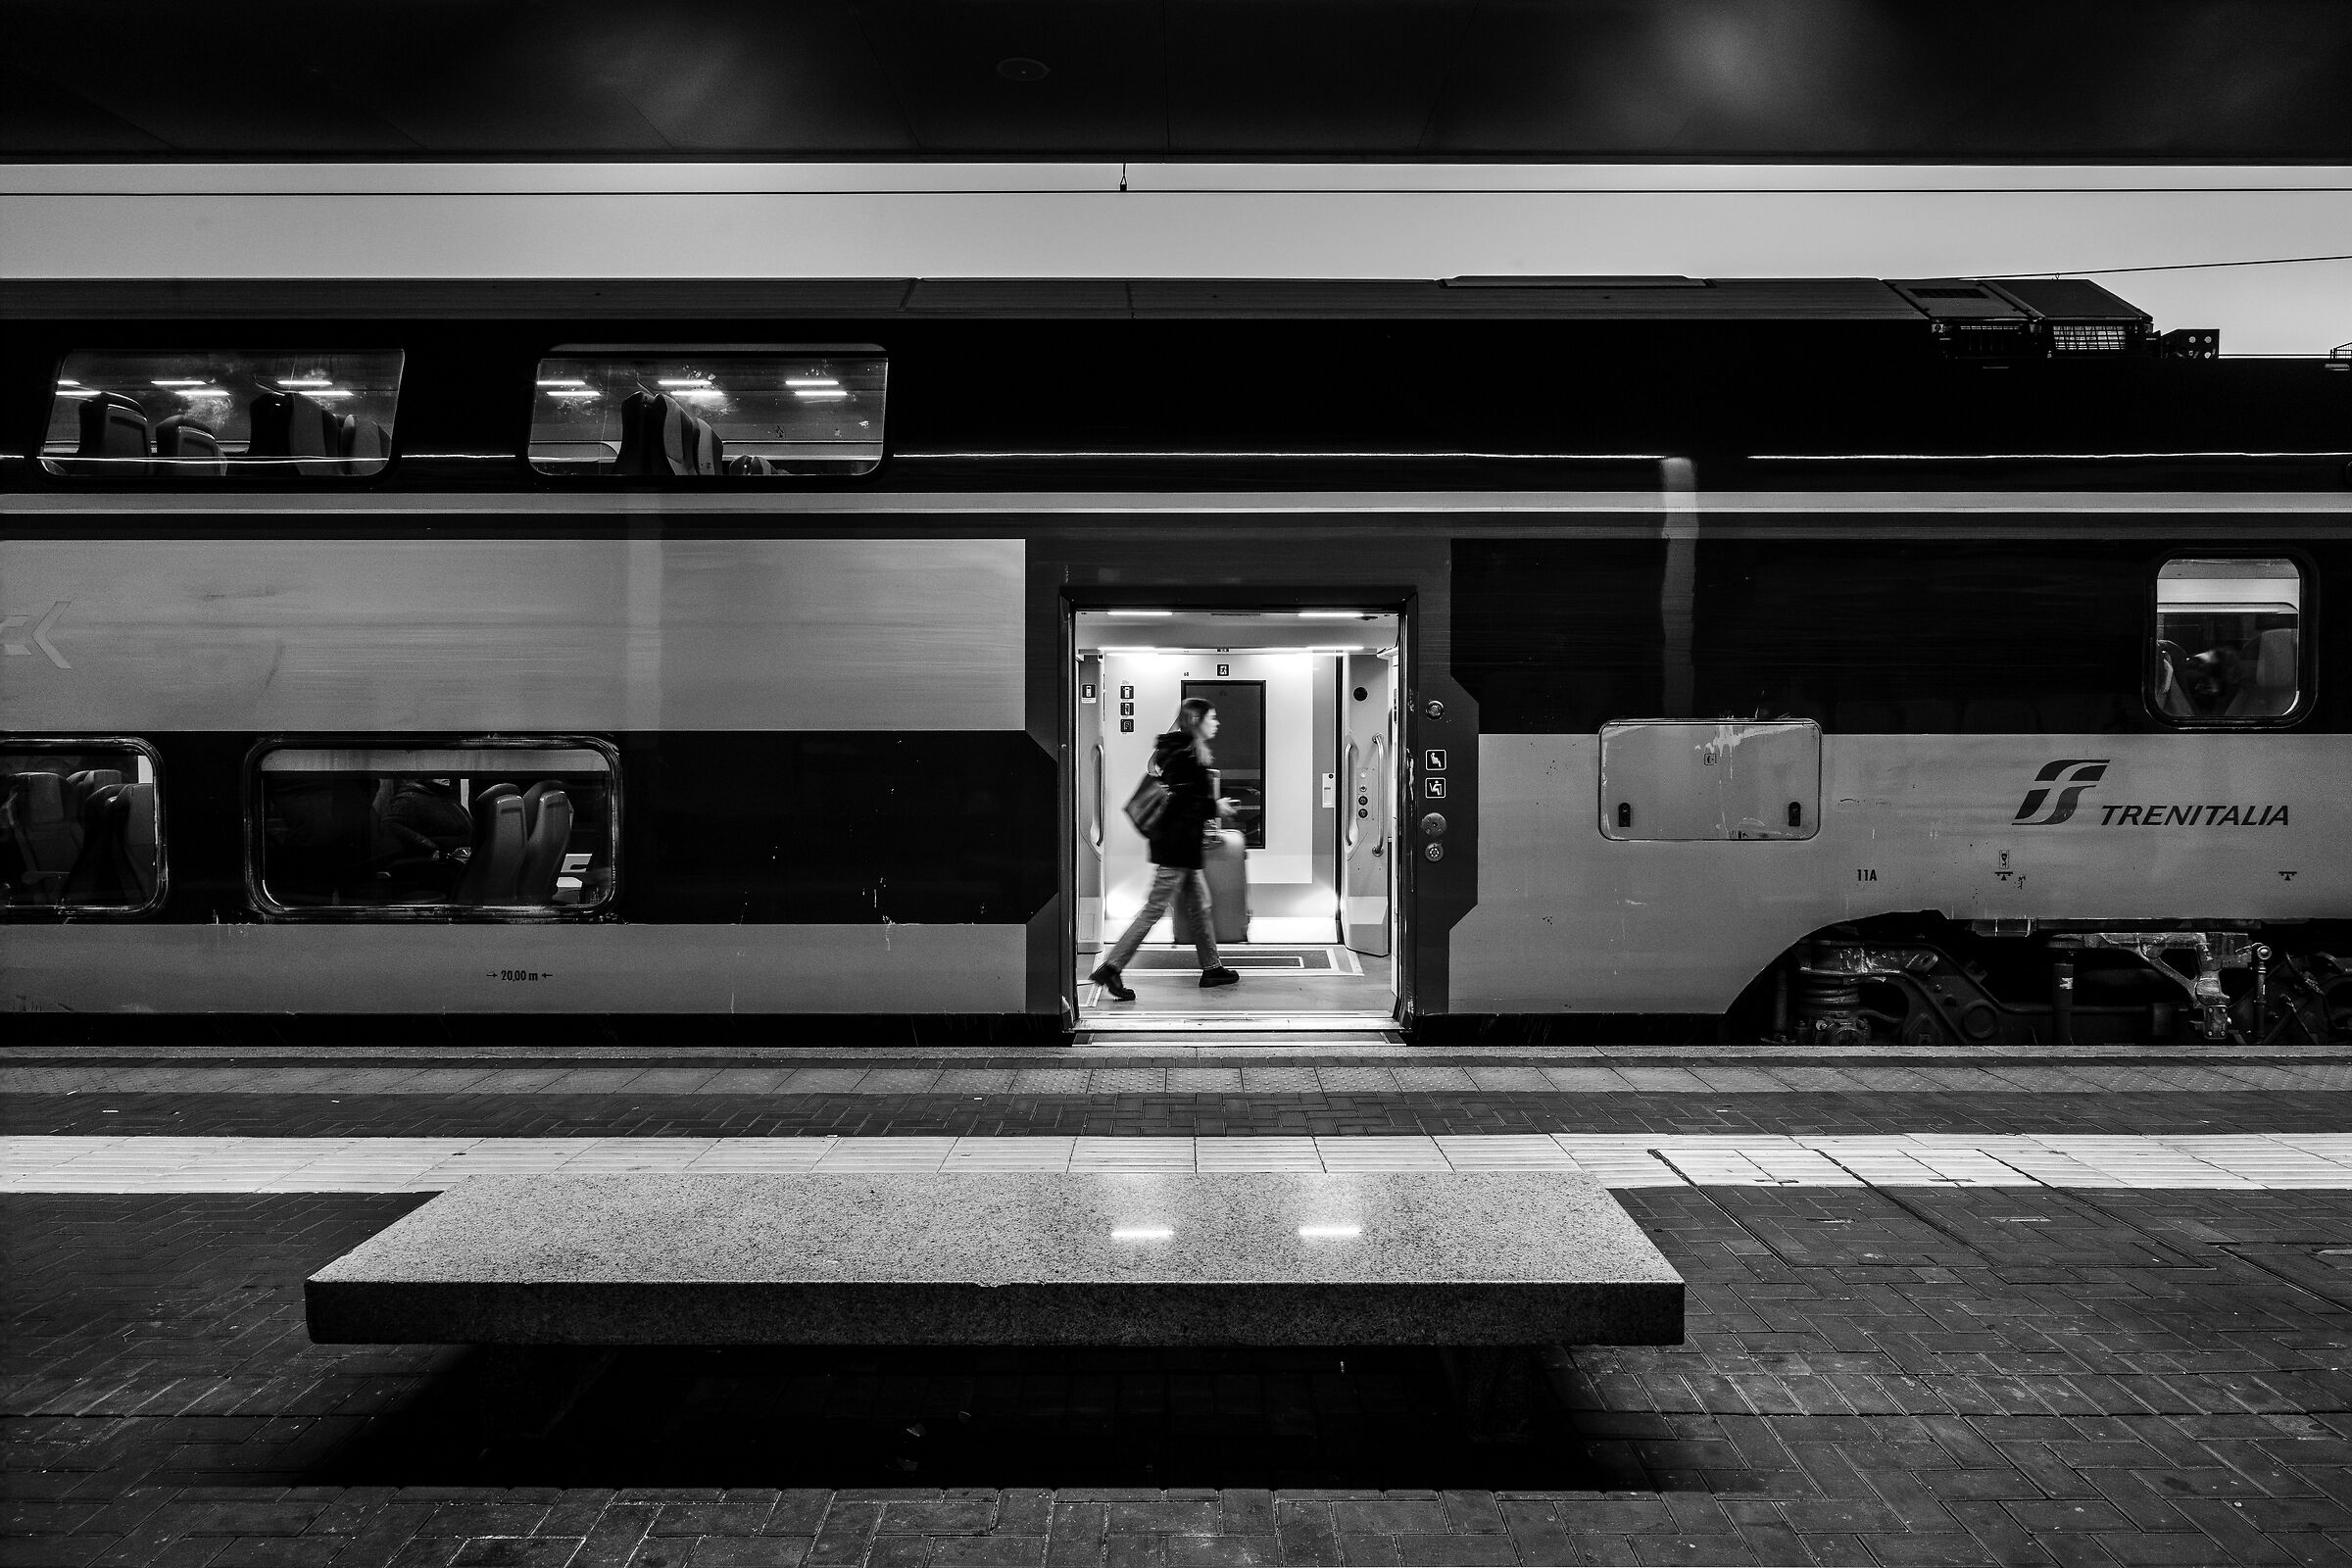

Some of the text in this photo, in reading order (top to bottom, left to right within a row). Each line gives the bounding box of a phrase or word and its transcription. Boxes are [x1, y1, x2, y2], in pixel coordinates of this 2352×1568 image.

[2100, 805, 2289, 826] TRENITALIA
[1857, 868, 1878, 882] 11A
[528, 972, 538, 982] m
